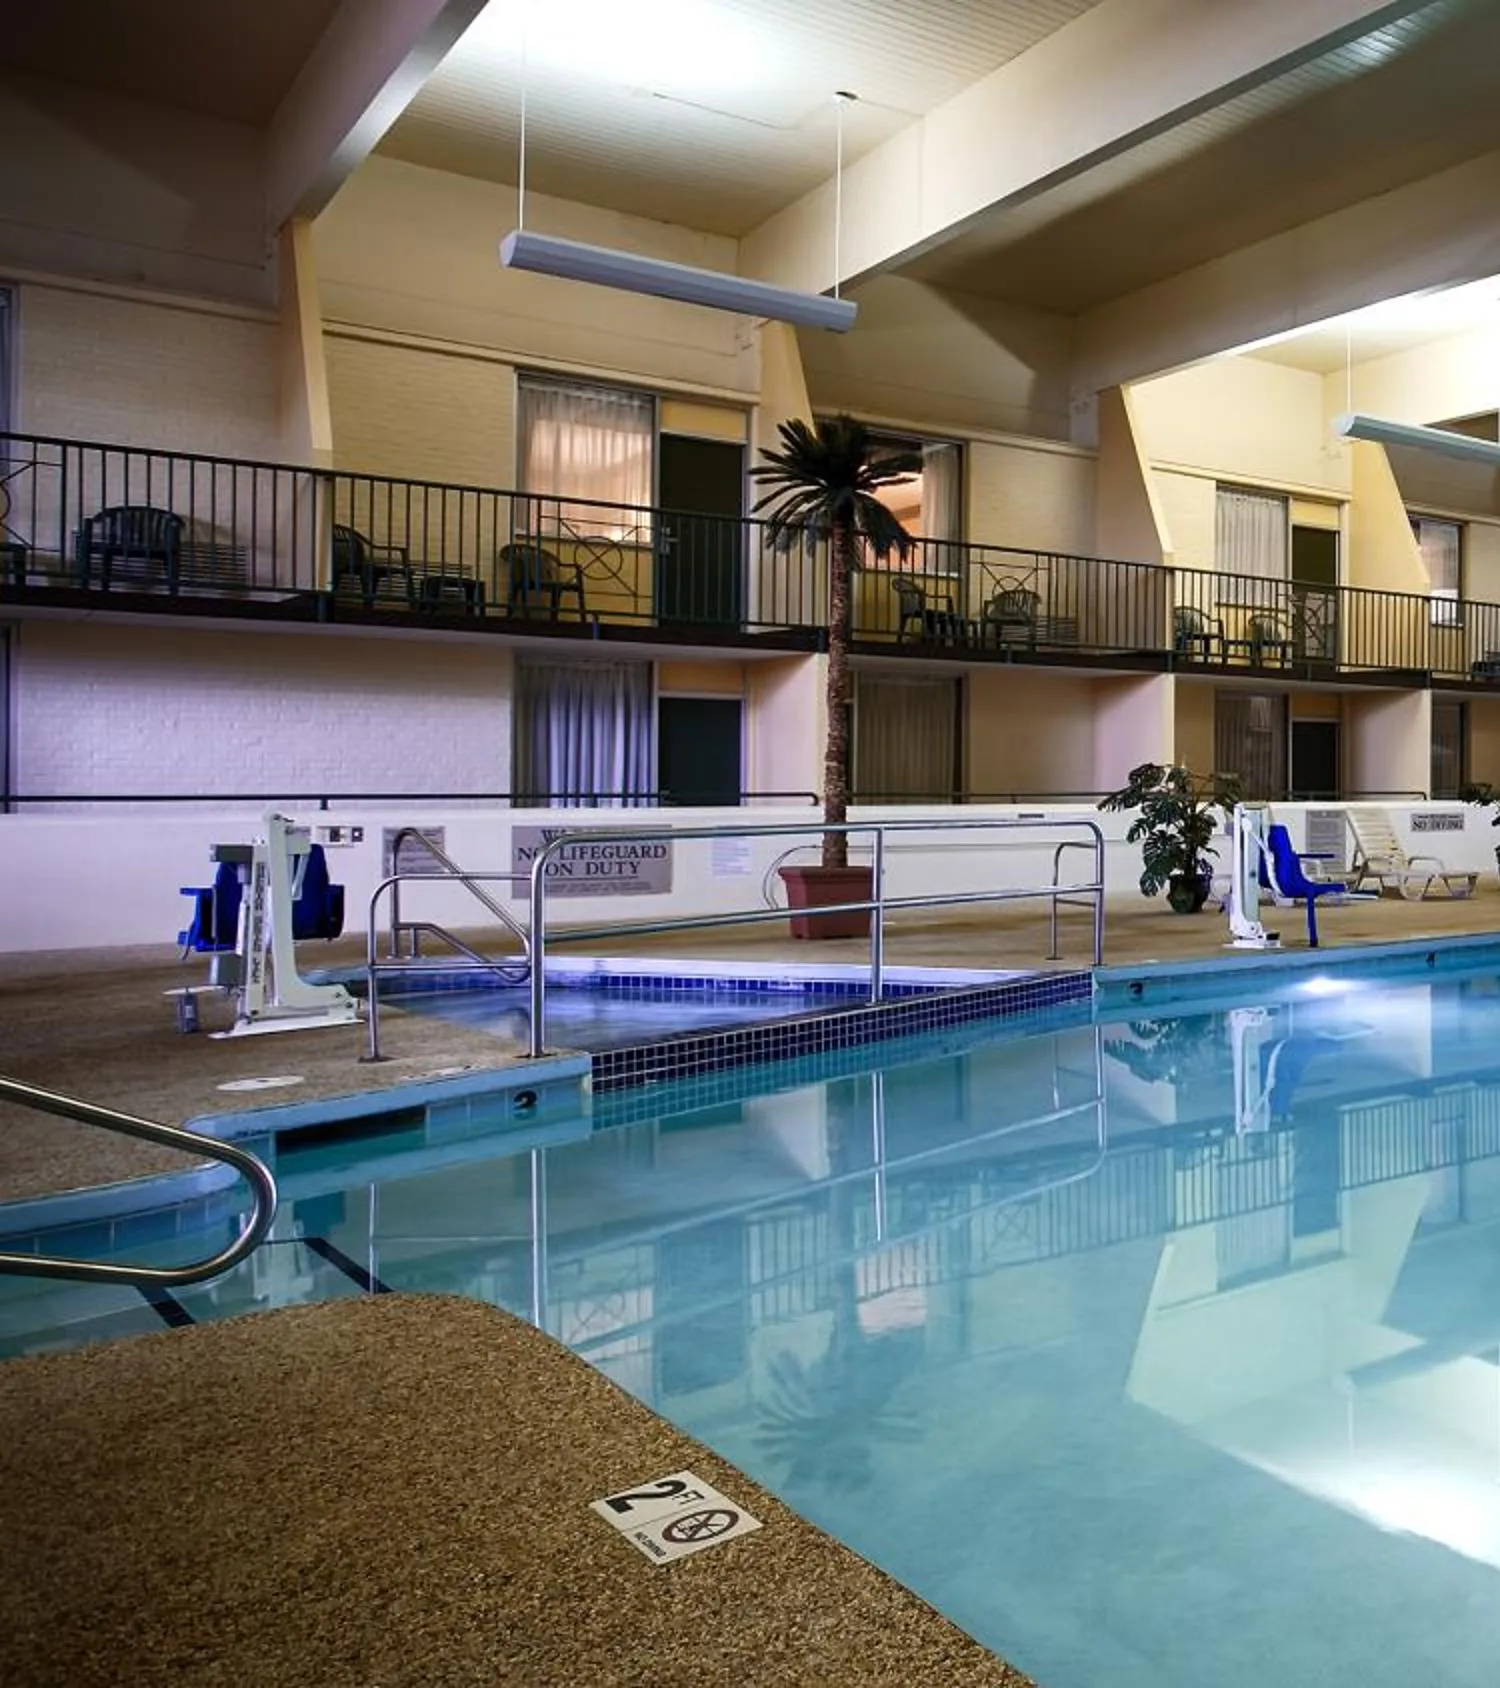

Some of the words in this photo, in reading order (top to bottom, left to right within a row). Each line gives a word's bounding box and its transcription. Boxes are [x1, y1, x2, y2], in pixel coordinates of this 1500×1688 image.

[559, 845, 667, 860] LIFEGUARD
[546, 862, 573, 876] ON
[586, 861, 640, 875] DUTY
[605, 1479, 688, 1514] 2
[672, 1489, 705, 1505] FT
